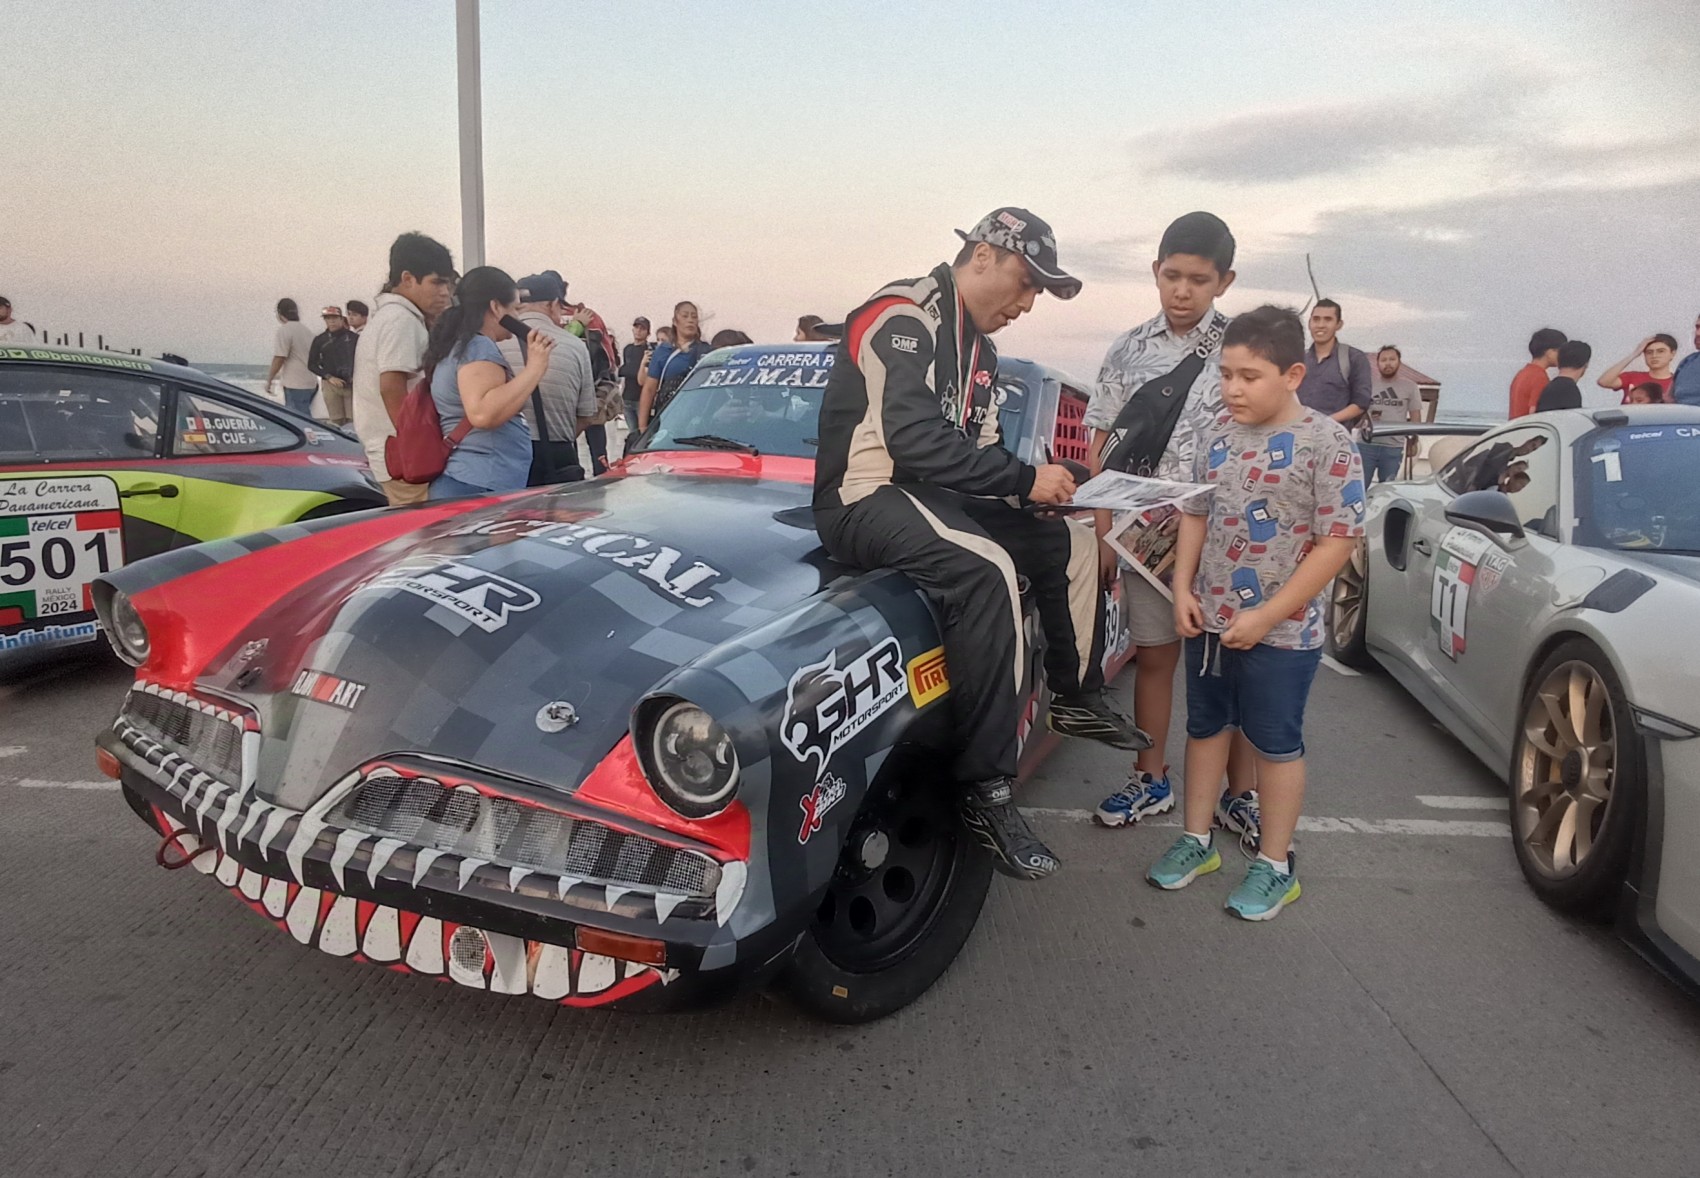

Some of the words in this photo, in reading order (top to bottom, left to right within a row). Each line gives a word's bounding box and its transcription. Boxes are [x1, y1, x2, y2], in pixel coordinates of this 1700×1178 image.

[891, 337, 918, 351] OMP
[757, 353, 820, 367] CARRERA
[207, 433, 220, 444] D.
[222, 433, 246, 444] CUE
[1590, 451, 1623, 482] 1
[3, 482, 28, 496] La
[35, 481, 92, 497] Carrera
[31, 518, 73, 532] telcel
[0, 531, 110, 586] 501
[45, 587, 71, 595] RALLY
[41, 600, 78, 615] 2024
[832, 682, 905, 745] MOTORSPORT
